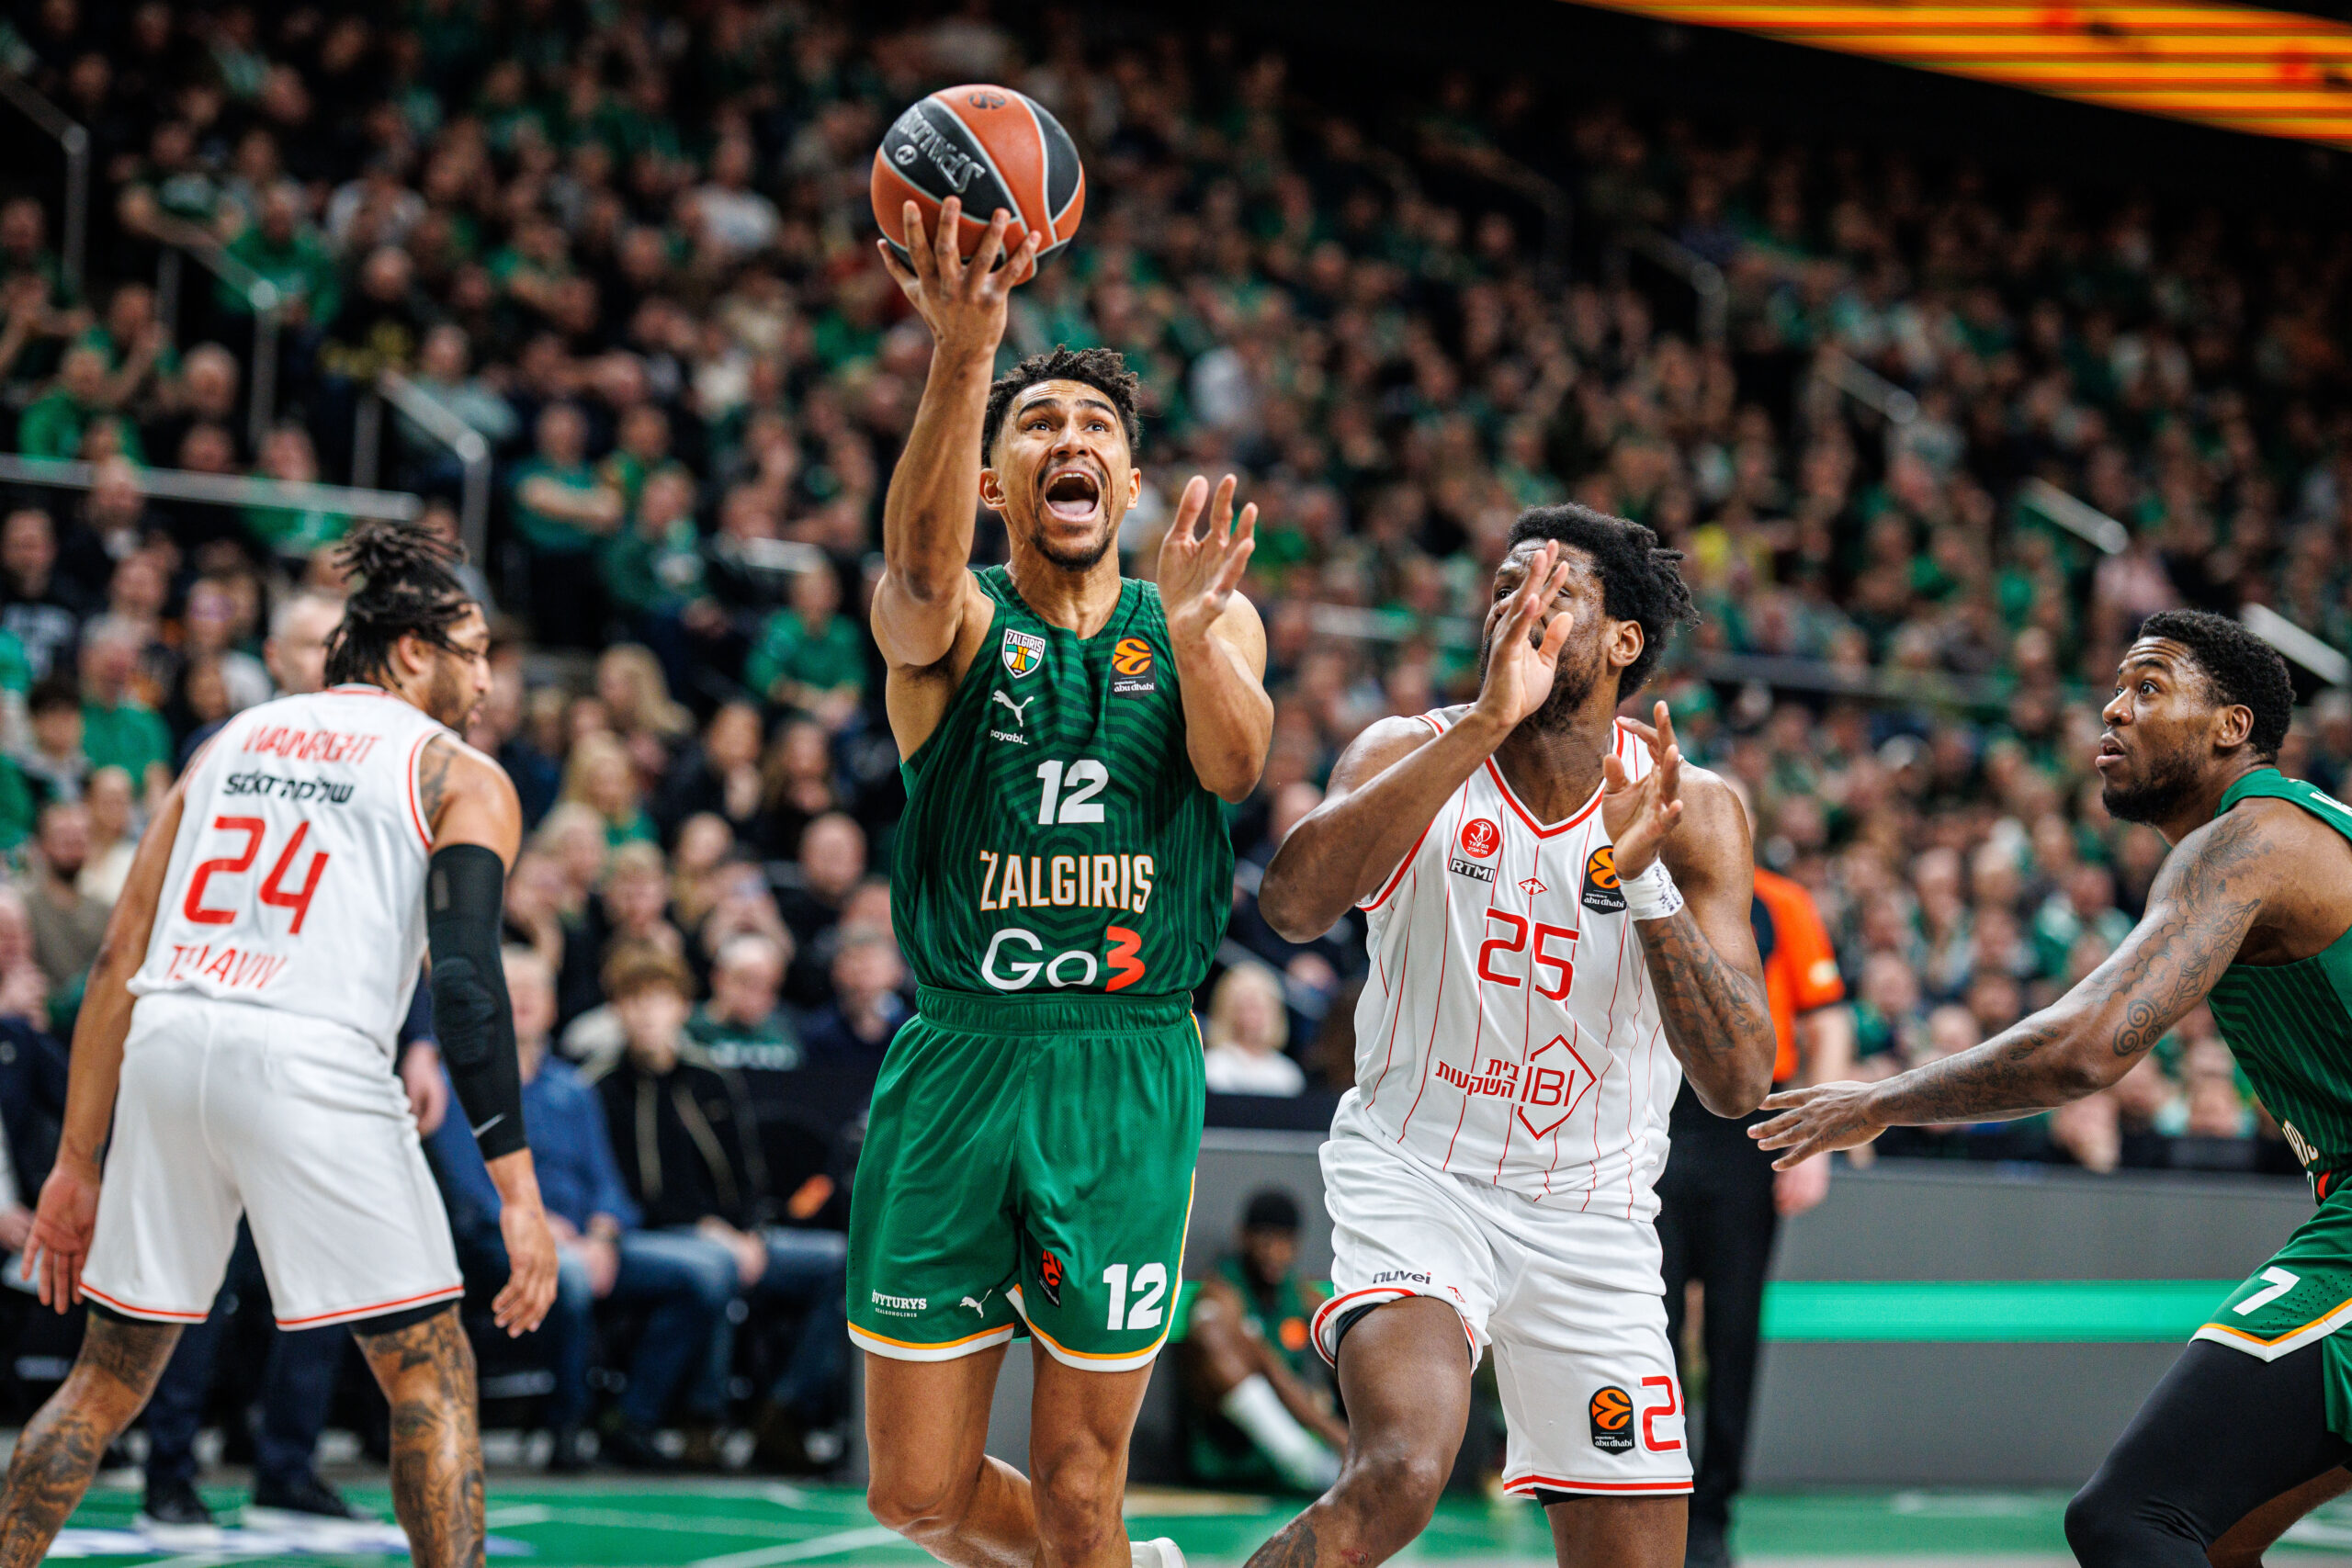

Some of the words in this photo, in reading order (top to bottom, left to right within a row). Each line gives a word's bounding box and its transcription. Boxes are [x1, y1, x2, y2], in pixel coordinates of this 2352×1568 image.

[1114, 684, 1130, 693] abu
[1131, 682, 1155, 692] dhabi
[1036, 760, 1109, 824] 12
[183, 816, 330, 935] 24
[1450, 860, 1495, 882] RTMI
[1584, 897, 1600, 905] abu
[1600, 899, 1625, 908] dhabi
[981, 925, 1146, 992] Go3
[1477, 908, 1579, 1000] 25
[1435, 1061, 1515, 1099] השקעות
[1486, 1058, 1520, 1081] בית
[1521, 1066, 1576, 1107] IBI
[1102, 1262, 1168, 1330] 12
[1373, 1270, 1431, 1284] nuvei
[2232, 1266, 2301, 1316] 7
[1641, 1375, 1688, 1451] 2
[1610, 1438, 1633, 1448] dhabi
